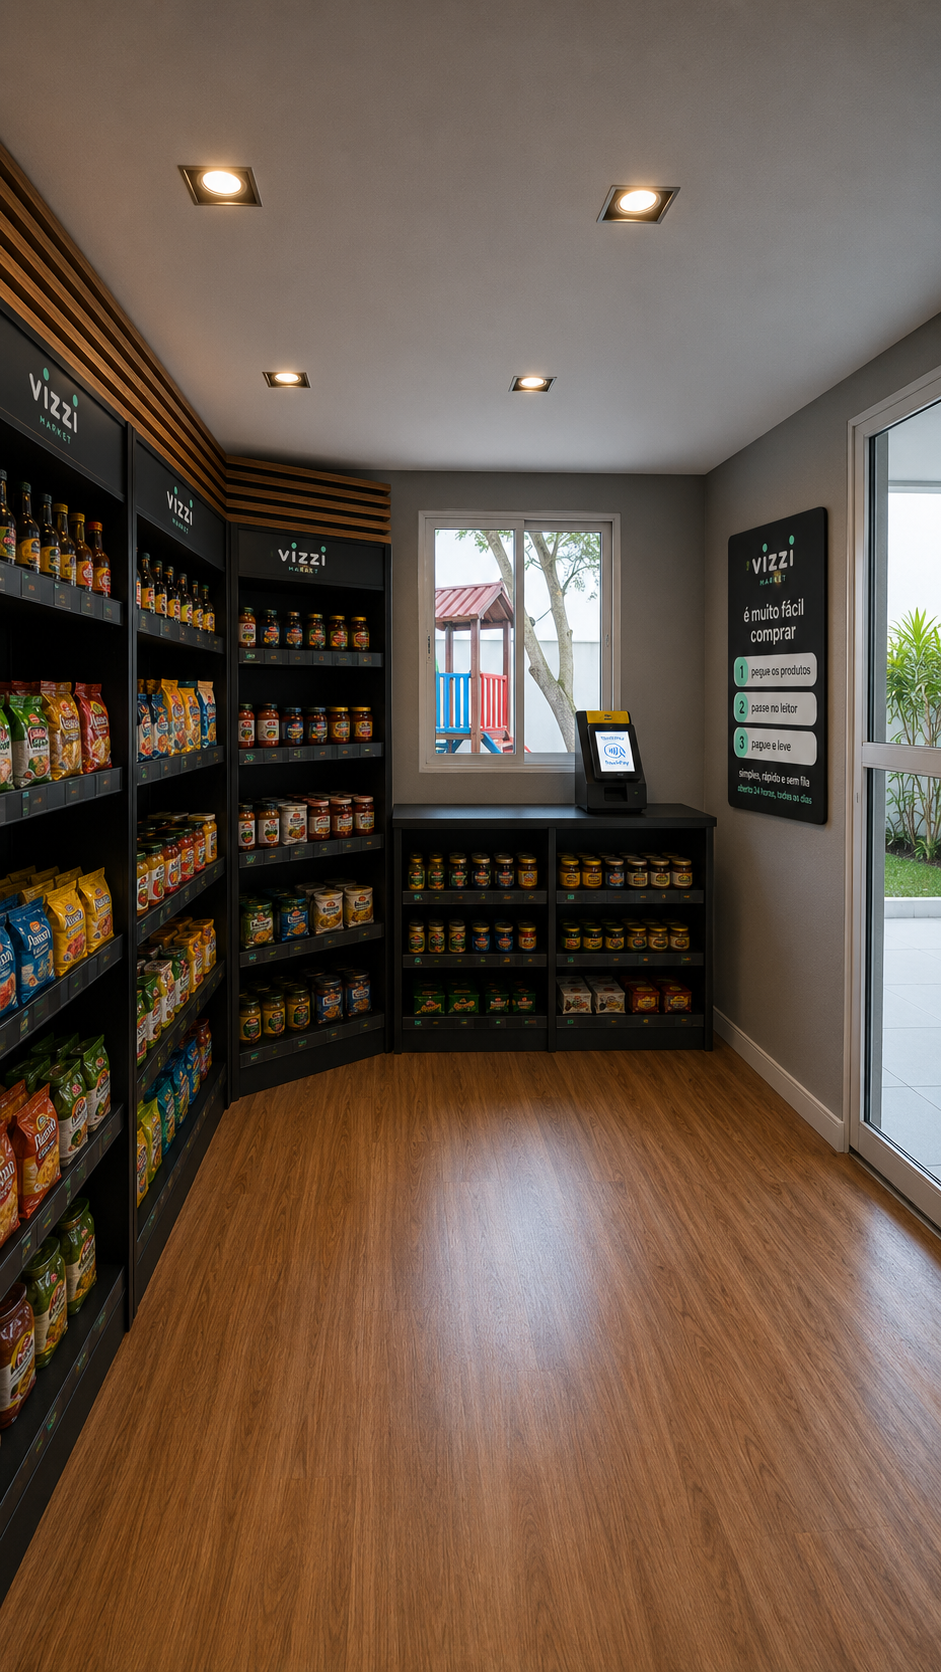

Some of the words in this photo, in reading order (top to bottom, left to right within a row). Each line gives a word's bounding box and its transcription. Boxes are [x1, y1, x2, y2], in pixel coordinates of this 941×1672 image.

[744, 606, 750, 622] é
[752, 604, 780, 622] muito
[782, 598, 804, 618] fácil
[750, 626, 796, 645] comprar
[740, 665, 744, 679] 1
[772, 668, 780, 676] os
[780, 664, 811, 678] produtos
[739, 700, 745, 714] 2
[751, 704, 770, 714] passe
[770, 704, 780, 713] no
[780, 702, 798, 714] leitor
[740, 736, 744, 750] 3
[772, 742, 777, 750] e
[778, 740, 792, 752] leve
